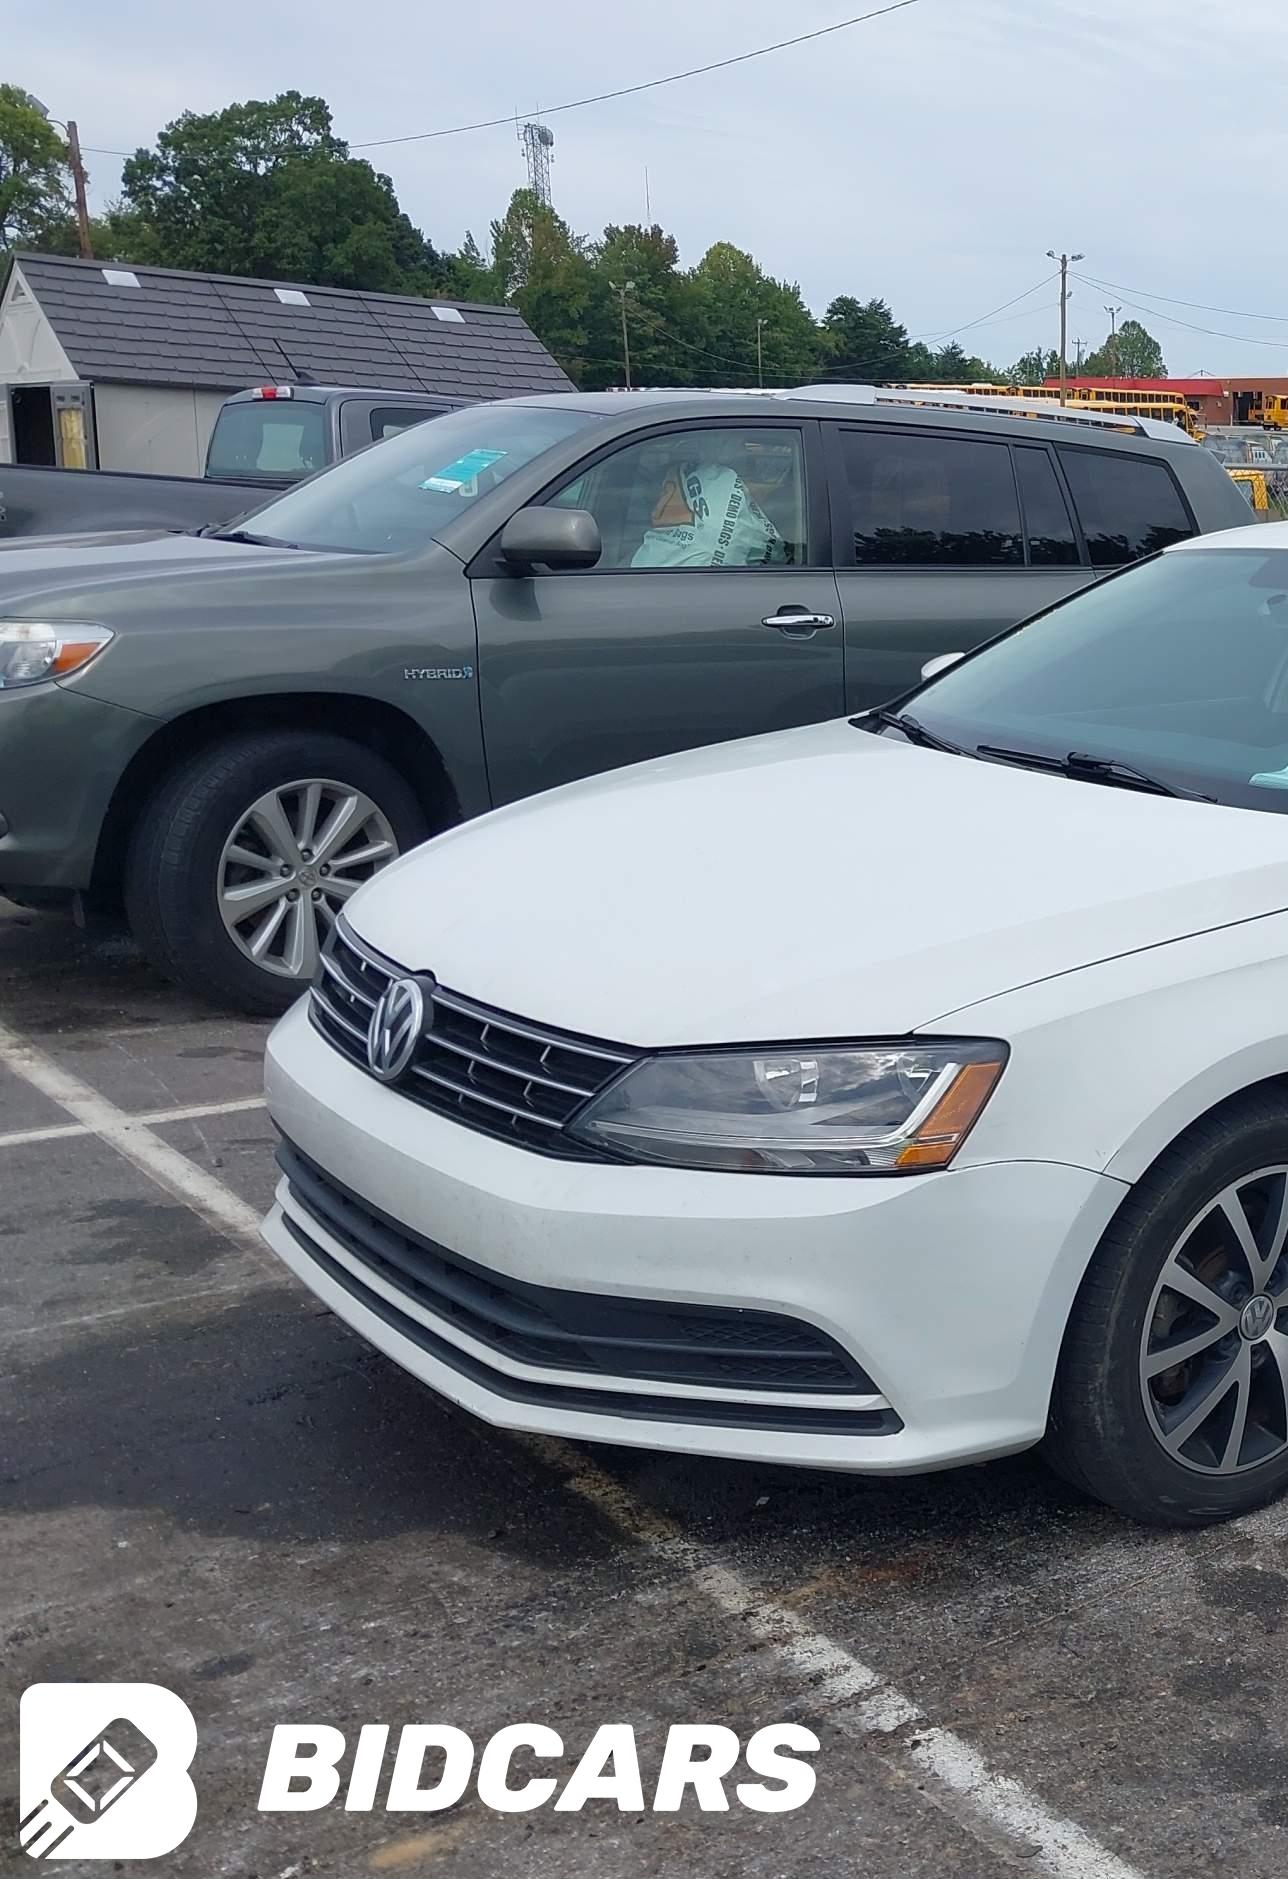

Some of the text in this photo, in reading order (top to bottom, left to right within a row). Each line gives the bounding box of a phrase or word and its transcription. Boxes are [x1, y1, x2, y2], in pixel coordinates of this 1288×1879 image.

[727, 492, 743, 519] DEMO
[717, 519, 736, 546] BAGS
[404, 668, 463, 680] HYBRID
